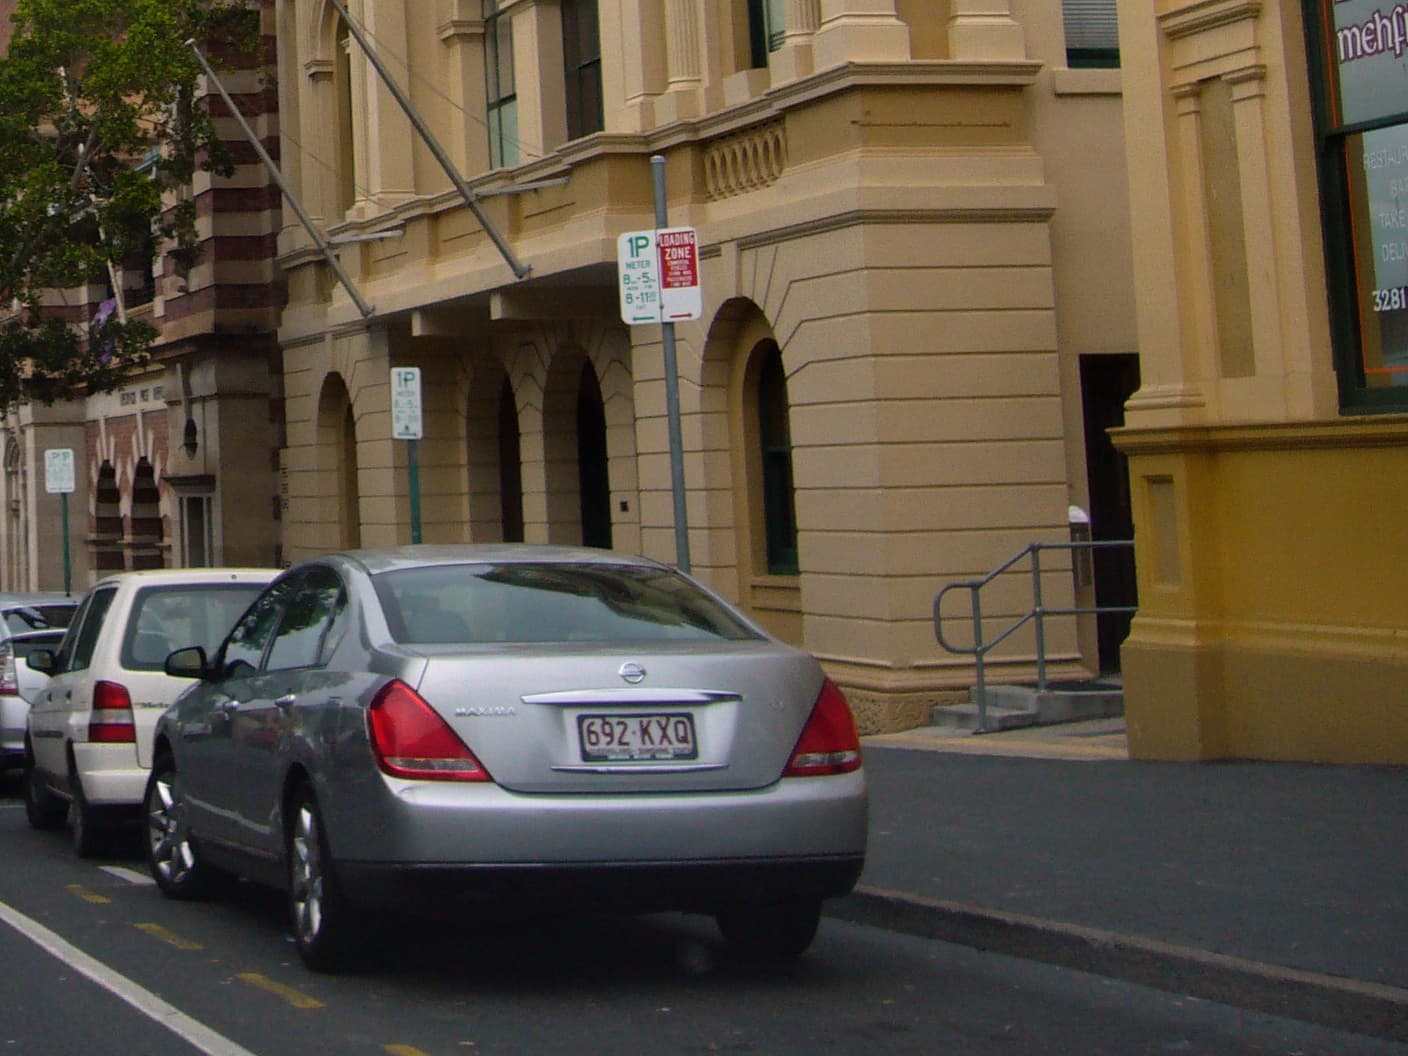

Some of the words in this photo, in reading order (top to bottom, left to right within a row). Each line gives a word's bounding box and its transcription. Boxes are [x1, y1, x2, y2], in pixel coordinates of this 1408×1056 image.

[628, 235, 649, 258] 1P
[659, 232, 694, 247] LOADING
[664, 246, 691, 260] ZONE
[625, 259, 650, 270] METER
[1372, 287, 1406, 312] 3281
